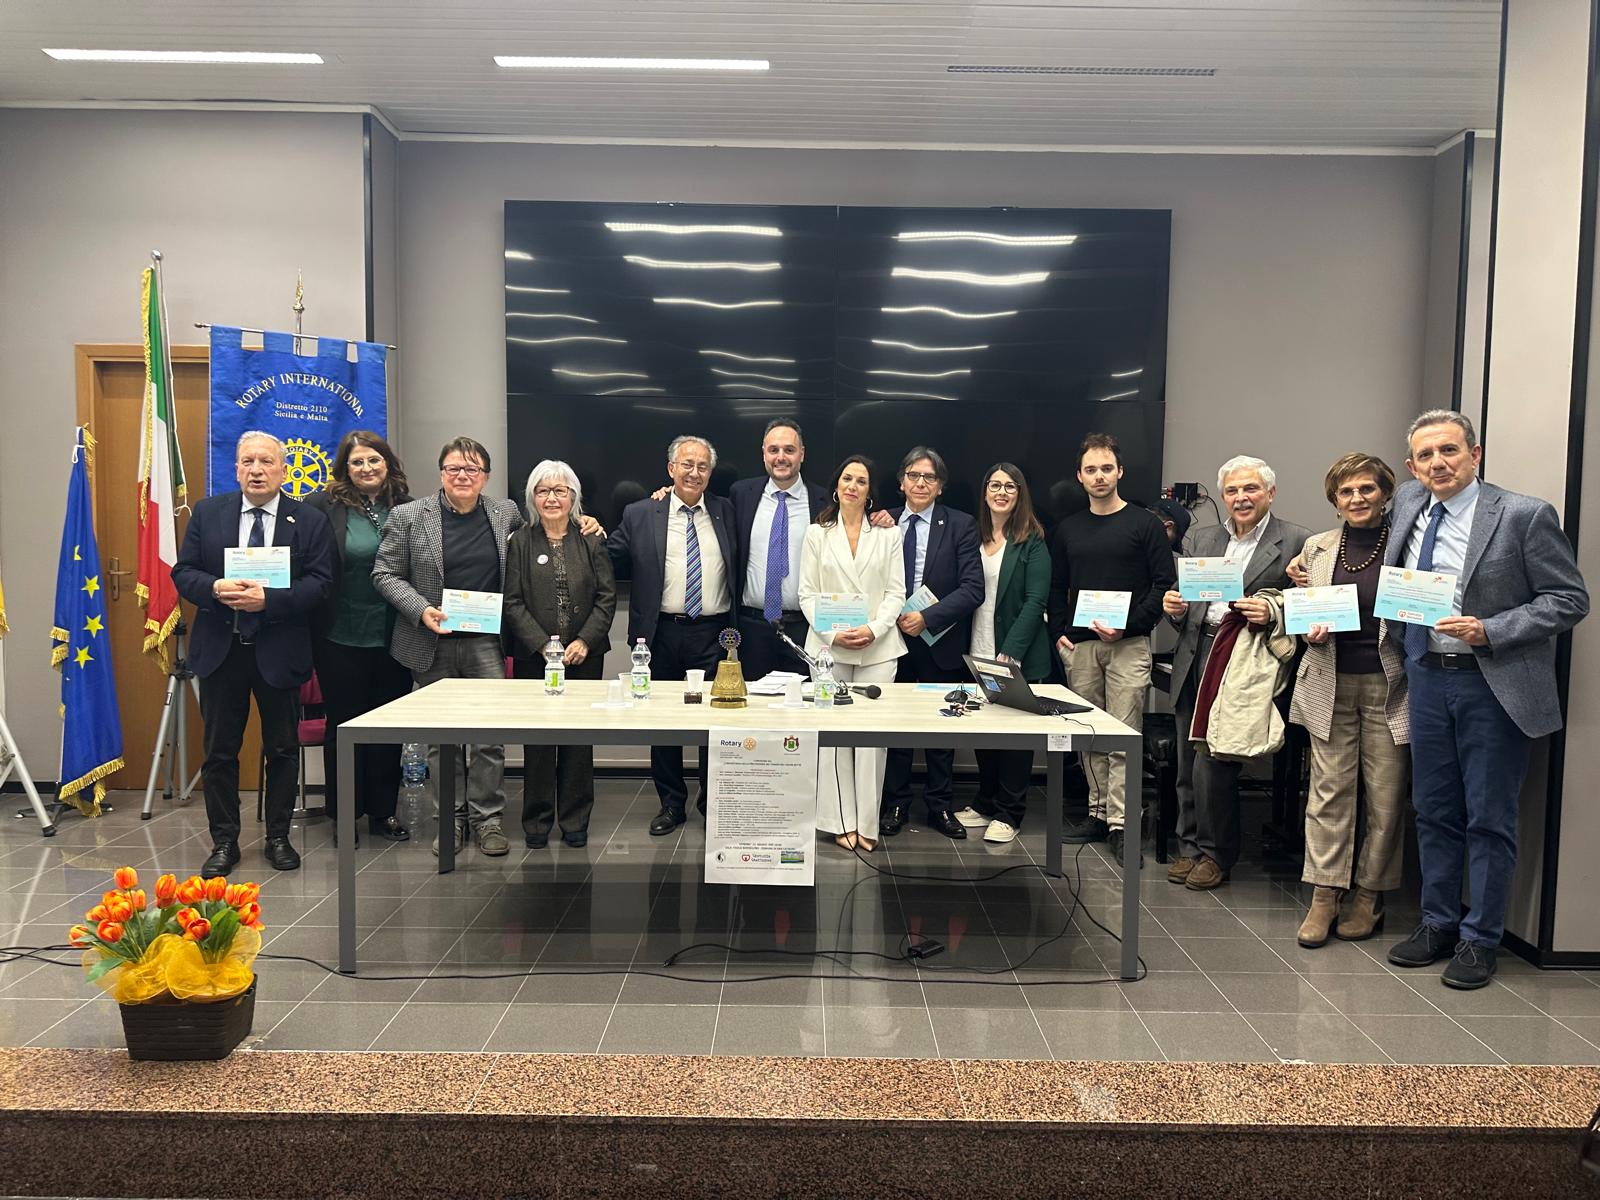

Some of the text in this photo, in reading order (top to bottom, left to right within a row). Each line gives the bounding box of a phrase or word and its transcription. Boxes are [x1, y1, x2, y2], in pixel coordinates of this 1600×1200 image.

[235, 376, 276, 409] ROTARY
[276, 402, 328, 413] Distretto 2110
[274, 411, 298, 419] Sicilia
[306, 413, 329, 421] Malta
[720, 739, 742, 747] Rotary
